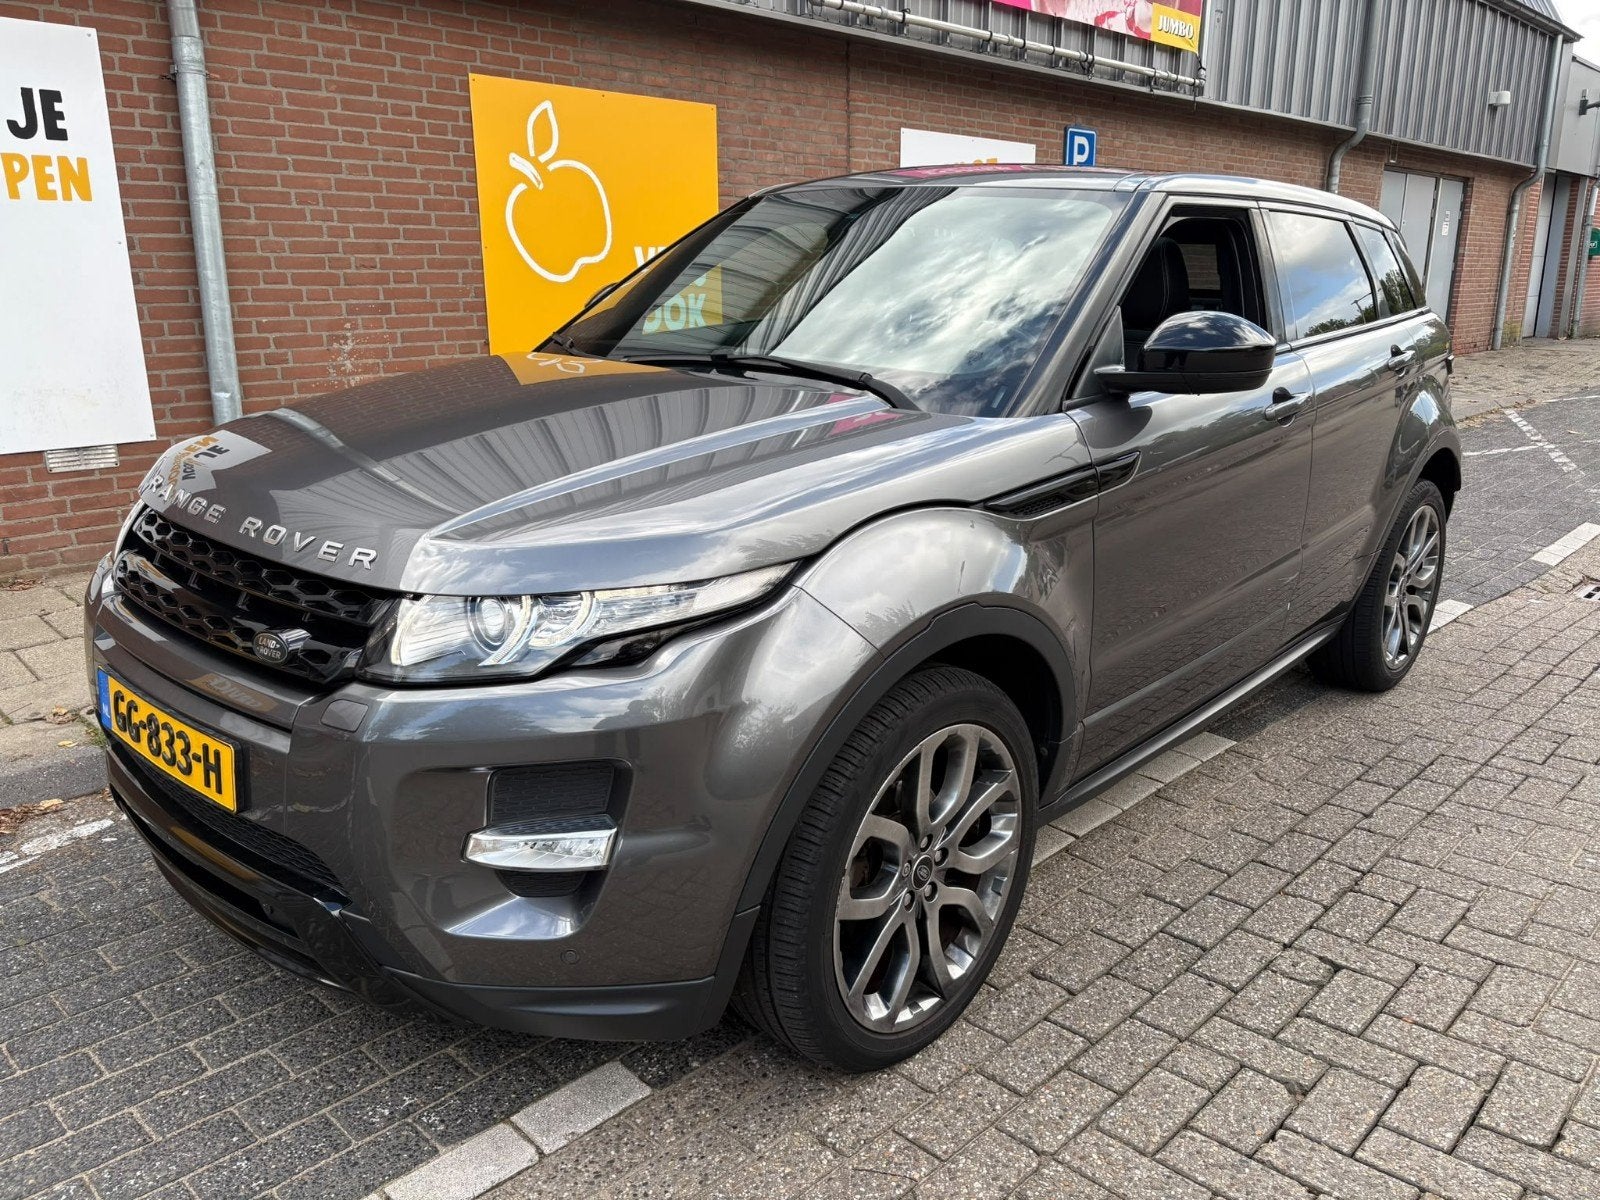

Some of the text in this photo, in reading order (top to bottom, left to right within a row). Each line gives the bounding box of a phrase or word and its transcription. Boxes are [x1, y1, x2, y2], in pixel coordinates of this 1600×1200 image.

[1158, 15, 1194, 39] JUMBO
[6, 87, 68, 141] JE
[1073, 136, 1090, 166] P
[0, 153, 92, 201] PEN
[149, 474, 378, 570] RANGE ROVER
[258, 636, 277, 649] LAND
[259, 647, 281, 659] ROVER
[113, 689, 223, 795] GG-833-H
